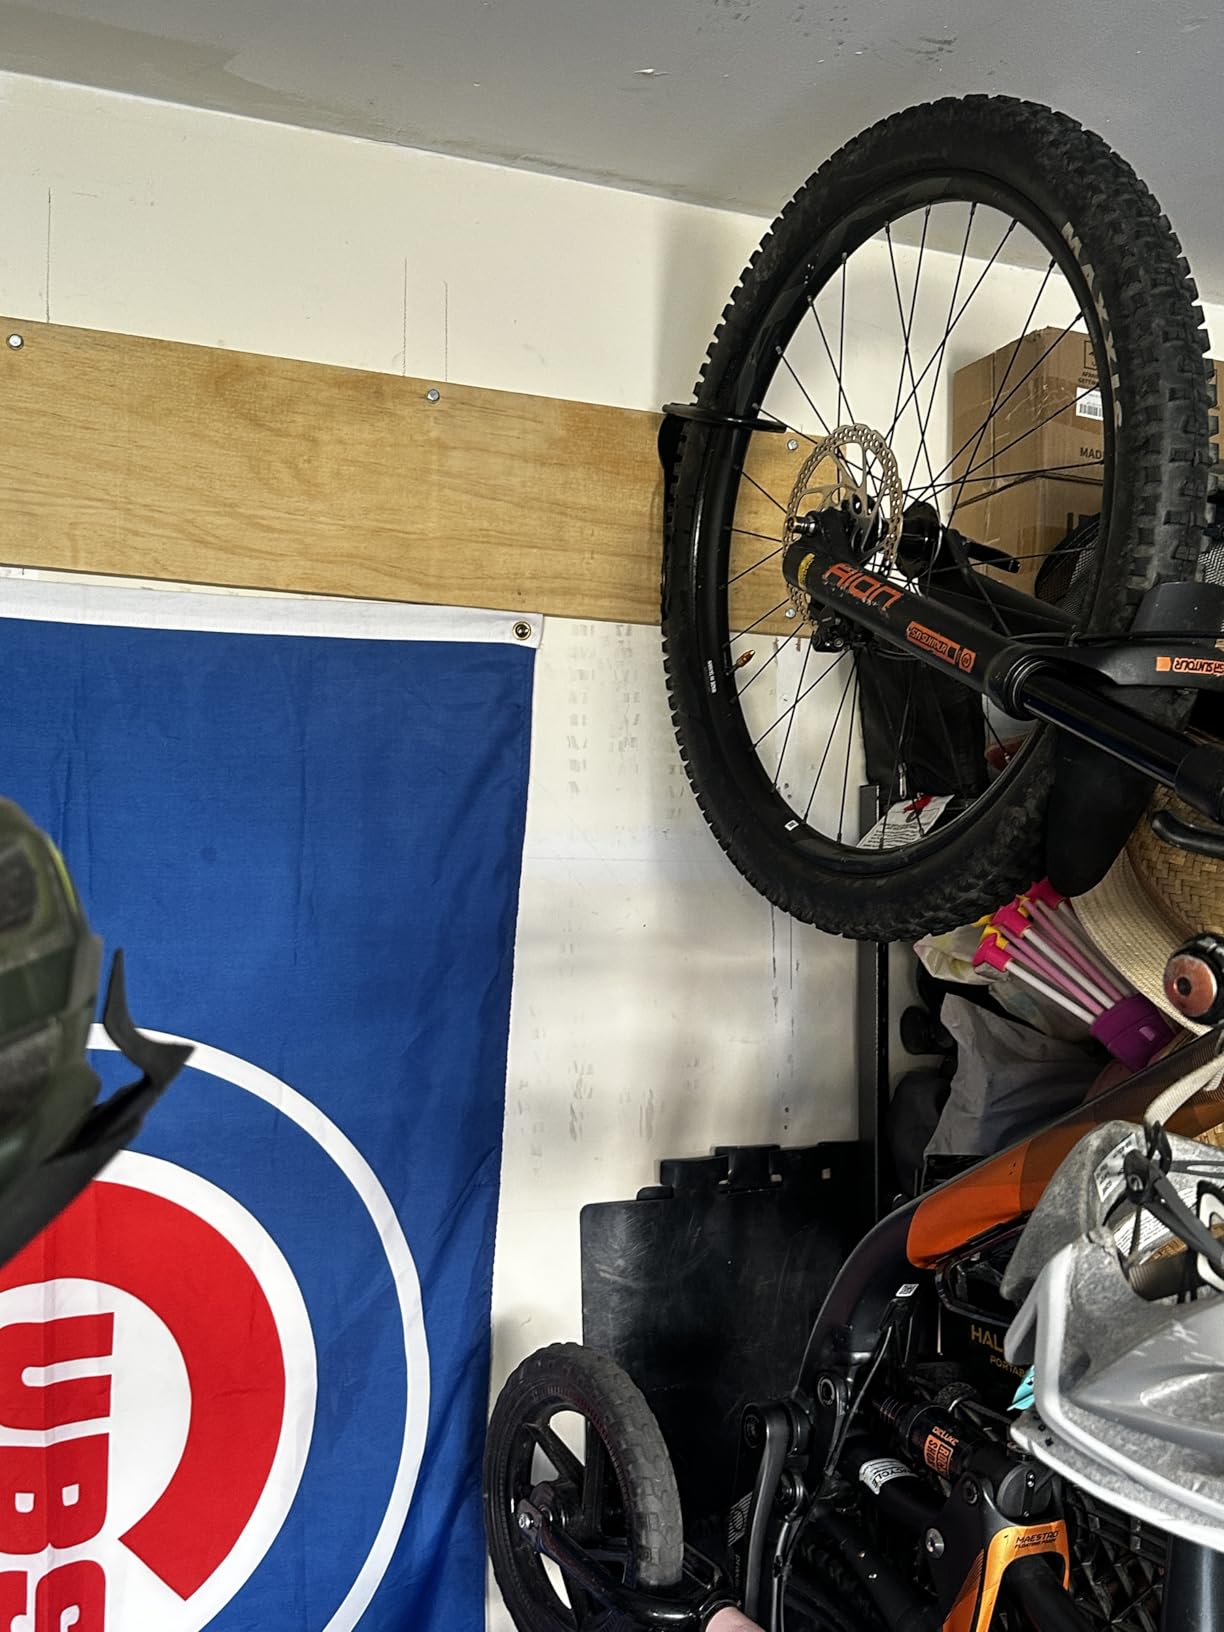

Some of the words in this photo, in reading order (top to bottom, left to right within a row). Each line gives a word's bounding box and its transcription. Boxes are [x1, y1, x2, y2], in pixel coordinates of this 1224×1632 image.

[1080, 447, 1104, 460] MAD
[971, 1324, 1004, 1353] HAL
[989, 1354, 1025, 1378] PORTAB
[1015, 1530, 1059, 1544] MAESTRO
